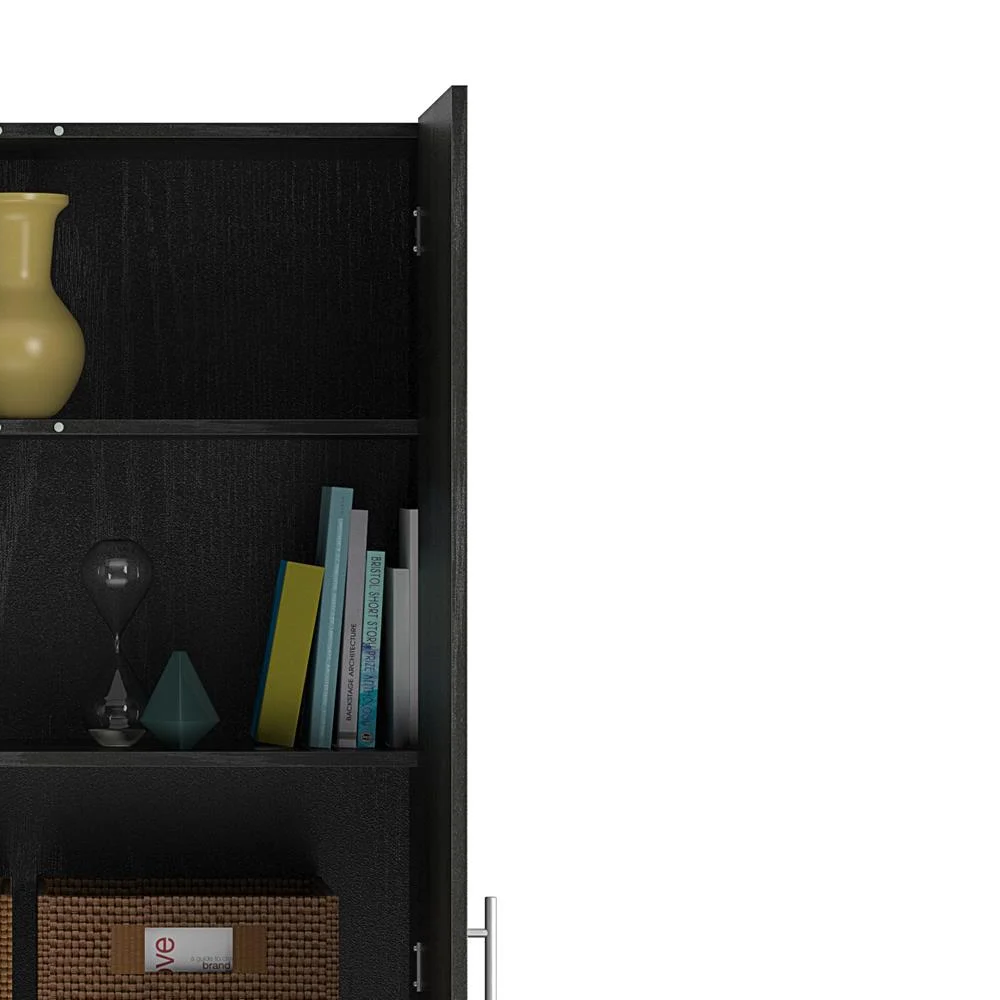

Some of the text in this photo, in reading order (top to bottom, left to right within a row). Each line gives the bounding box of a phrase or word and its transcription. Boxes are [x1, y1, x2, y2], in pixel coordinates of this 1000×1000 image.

[368, 556, 382, 588] BRISTOL
[368, 591, 379, 619] SHORT
[346, 623, 357, 721] BACKSTAGE ARCHITECTURE
[202, 961, 231, 970] brand
